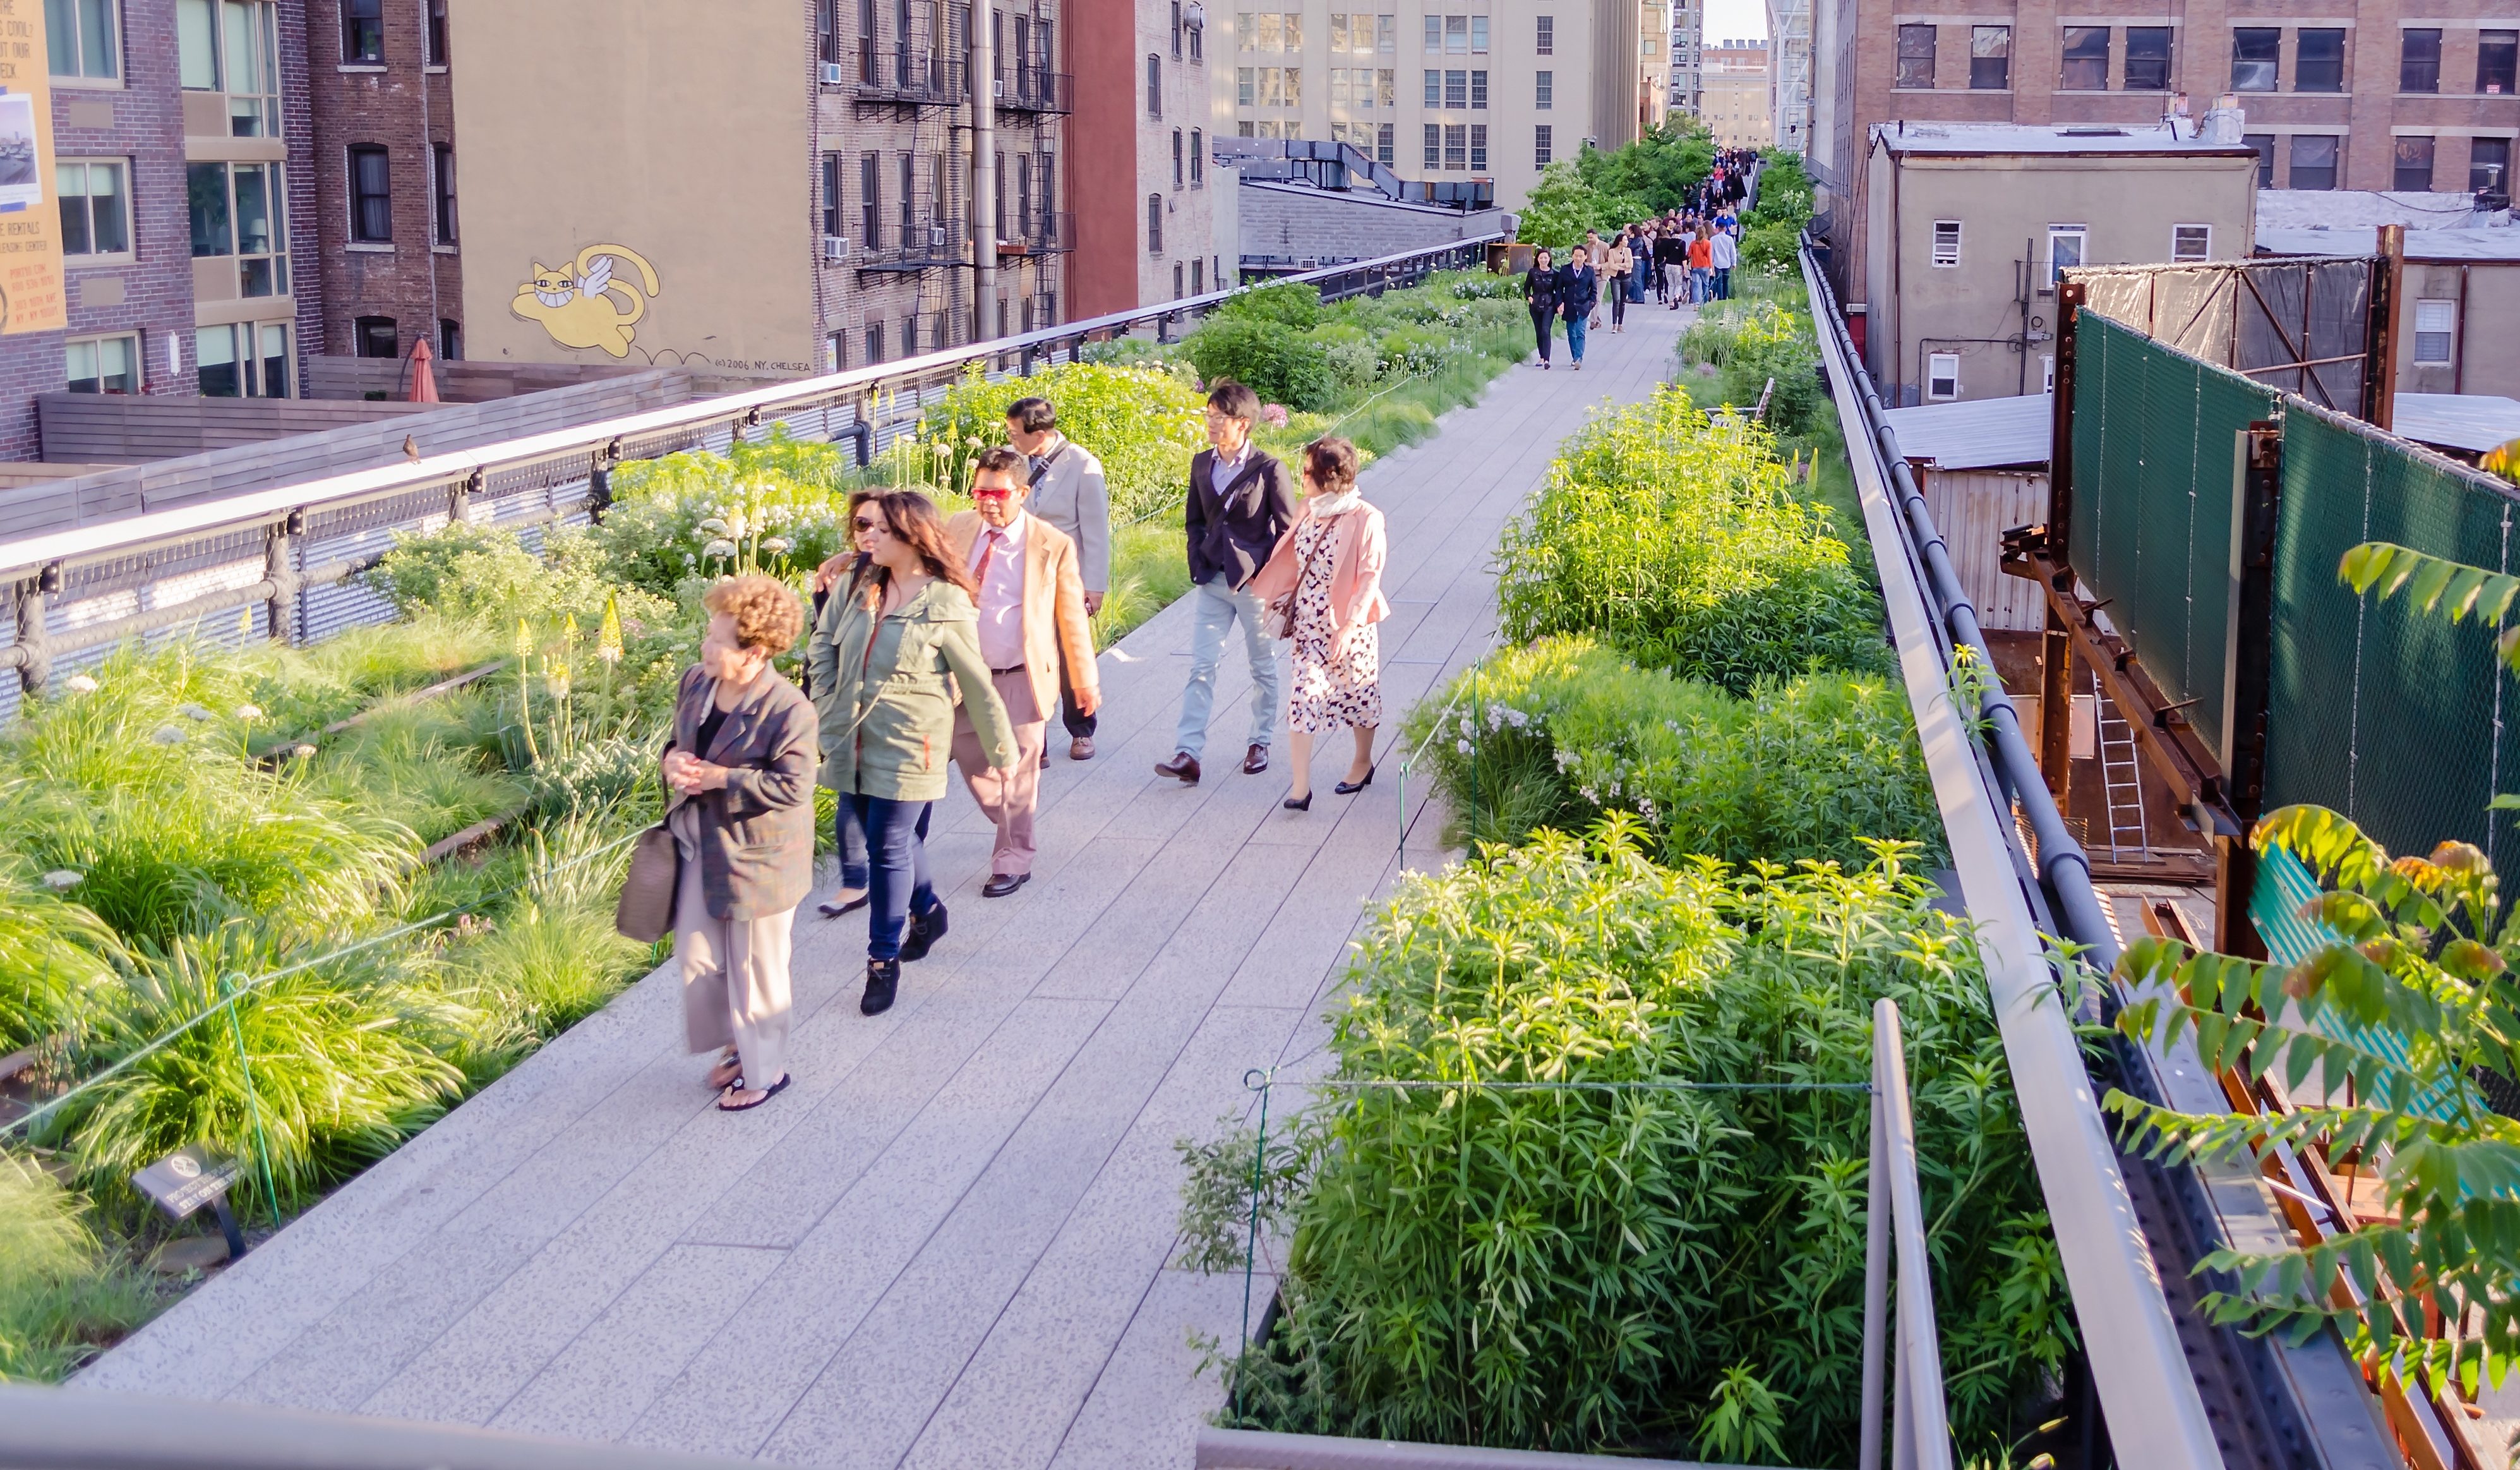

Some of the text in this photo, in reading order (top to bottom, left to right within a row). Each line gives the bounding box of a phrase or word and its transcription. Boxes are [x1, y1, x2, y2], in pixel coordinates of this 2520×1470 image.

[8, 21, 33, 38] COOL?
[13, 42, 30, 59] OUR
[0, 63, 20, 80] ECK.
[8, 222, 40, 236] RENTALS
[728, 359, 749, 370] 2006
[771, 362, 810, 371] CHELSEA
[179, 1193, 200, 1209] STAY
[198, 1186, 213, 1198] ON
[210, 1177, 228, 1191] THE
